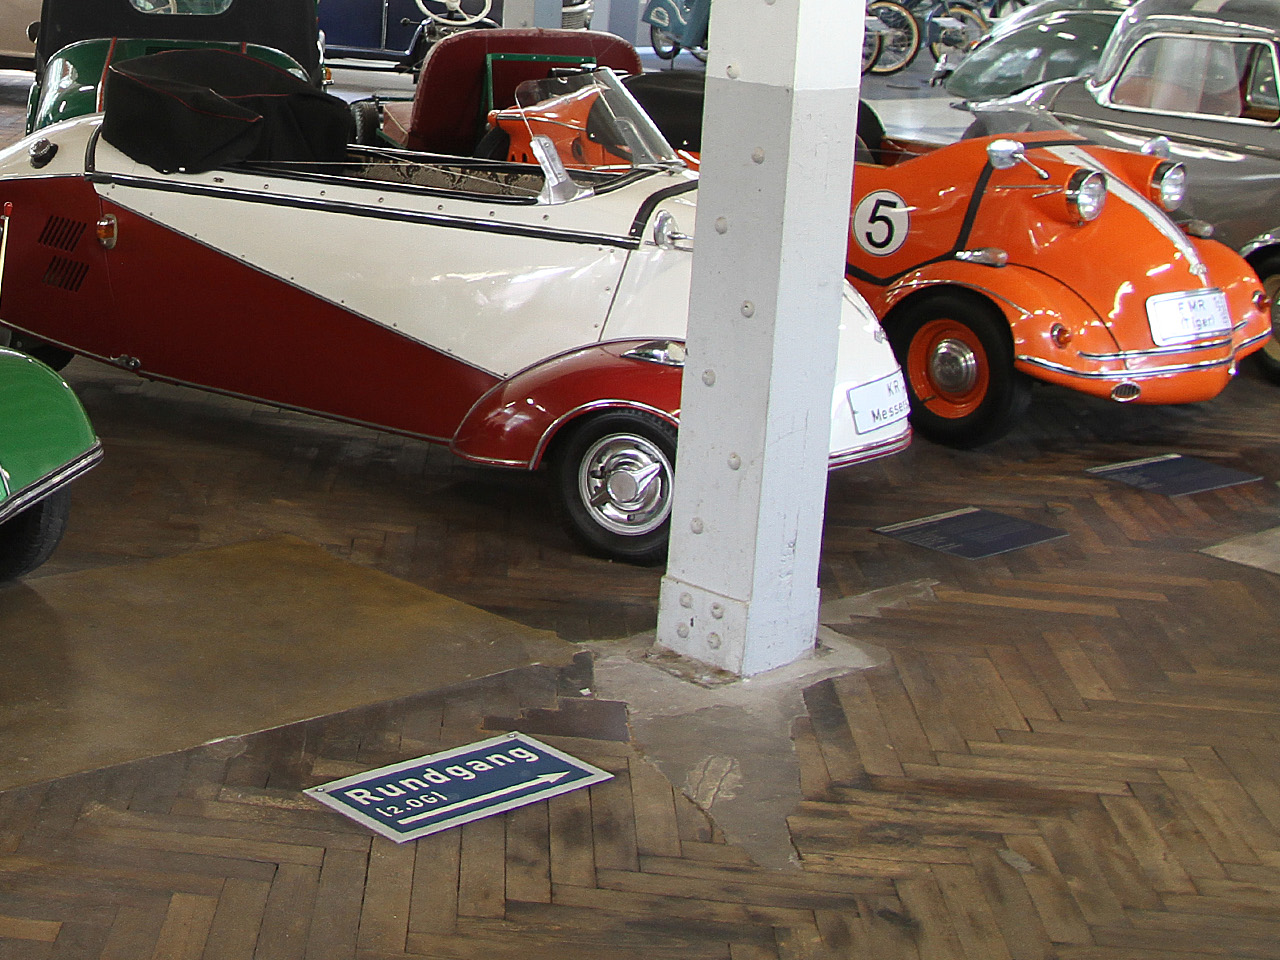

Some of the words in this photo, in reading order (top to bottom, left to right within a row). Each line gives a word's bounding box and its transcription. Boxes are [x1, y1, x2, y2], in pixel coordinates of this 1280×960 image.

[865, 198, 897, 248] 5
[886, 379, 901, 397] KR
[344, 745, 541, 806] Rundgang
